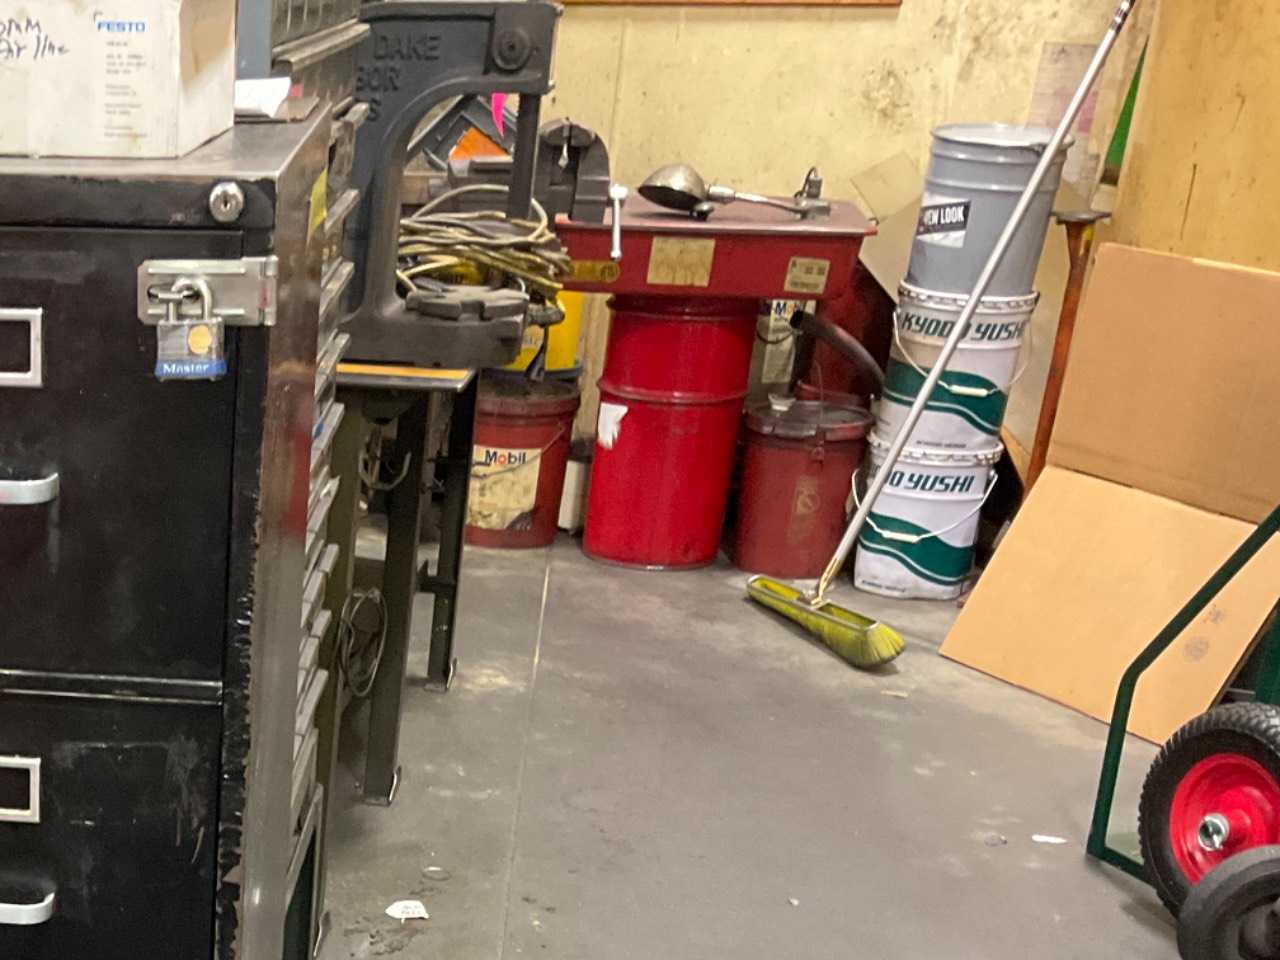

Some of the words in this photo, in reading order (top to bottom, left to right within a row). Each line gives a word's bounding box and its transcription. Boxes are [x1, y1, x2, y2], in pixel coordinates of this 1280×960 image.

[96, 20, 146, 33] FESTO
[373, 35, 442, 61] DAKE
[354, 65, 401, 93] BOR
[940, 204, 965, 225] LOOK
[162, 362, 210, 375] Master
[484, 449, 527, 465] Mobil
[904, 472, 975, 493] YUSHI
